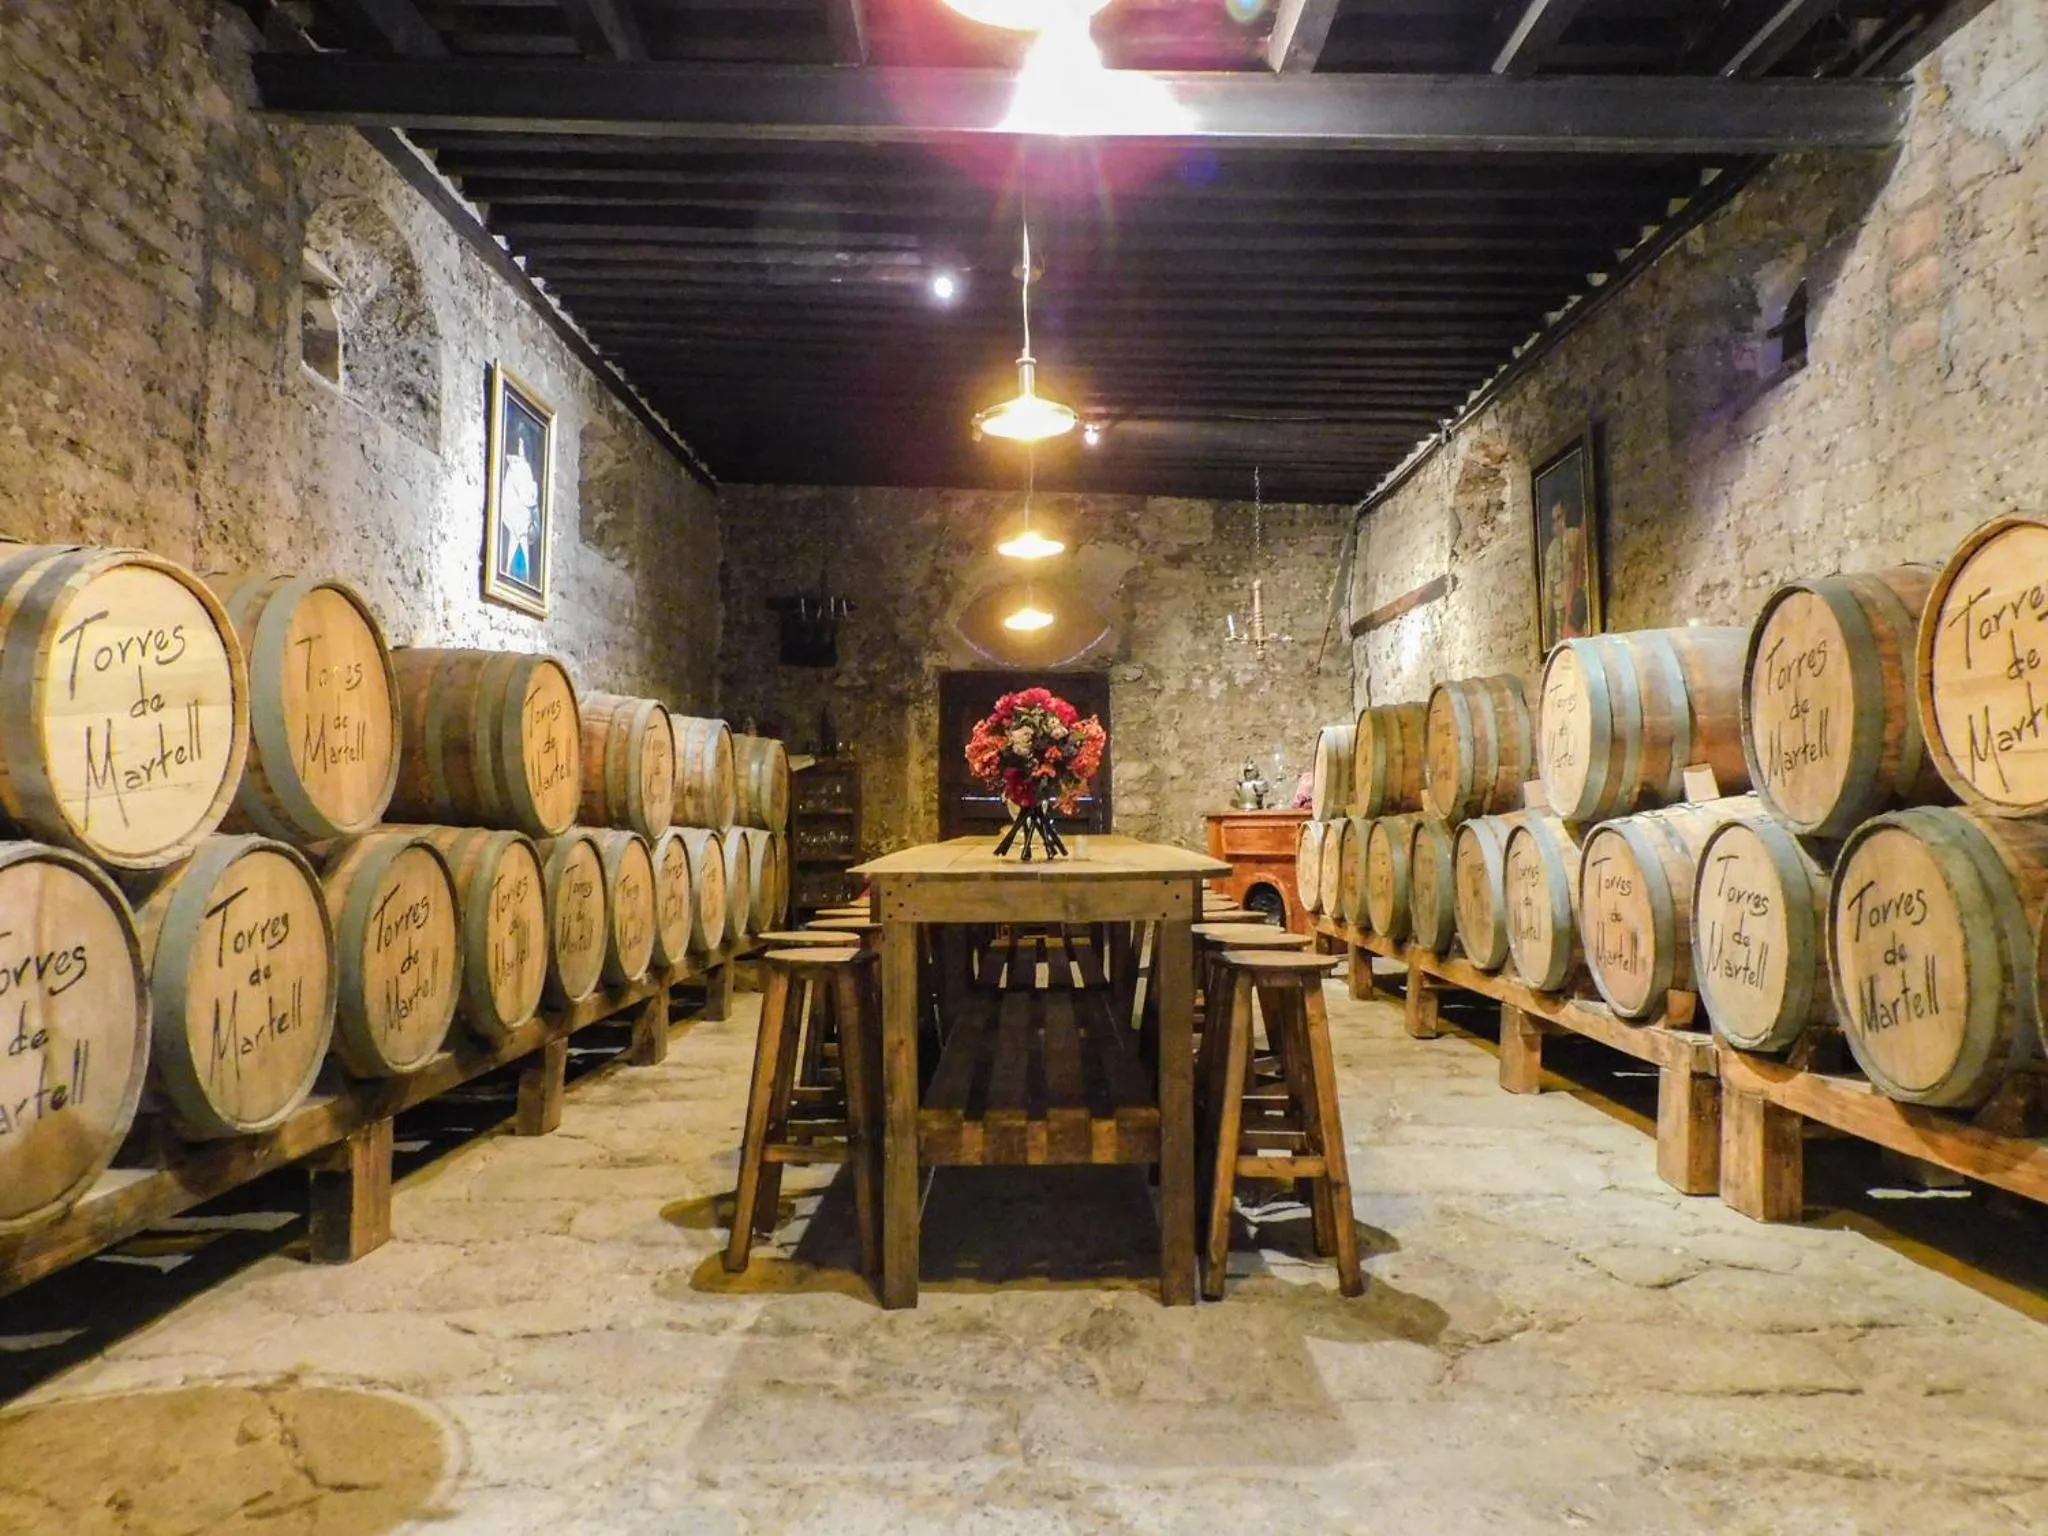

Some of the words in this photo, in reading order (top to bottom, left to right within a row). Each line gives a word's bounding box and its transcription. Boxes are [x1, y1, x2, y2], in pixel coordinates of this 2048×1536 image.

[59, 610, 185, 700] Torres
[1948, 586, 2048, 670] Torre
[2007, 628, 2041, 680] de
[130, 664, 165, 719] de
[1765, 637, 1828, 695] Torres
[1789, 686, 1811, 720] de
[1969, 680, 2048, 793] Mart
[84, 699, 202, 832] Martell
[302, 711, 366, 781] Martell
[1766, 707, 1830, 788] Martell
[373, 883, 430, 953] Torres
[1717, 855, 1769, 917] Torres
[1848, 880, 1928, 943] Torres
[206, 886, 289, 968] Torres
[401, 936, 419, 974] de
[1706, 920, 1769, 992] Martell
[1732, 911, 1750, 948] de
[1884, 930, 1907, 965] de
[0, 931, 87, 996] orres
[249, 954, 272, 986] de
[384, 946, 439, 1044] Martell
[1859, 954, 1939, 1041] Martell
[9, 1001, 49, 1056] de
[209, 976, 302, 1085] Martell
[0, 1039, 89, 1135] artell
